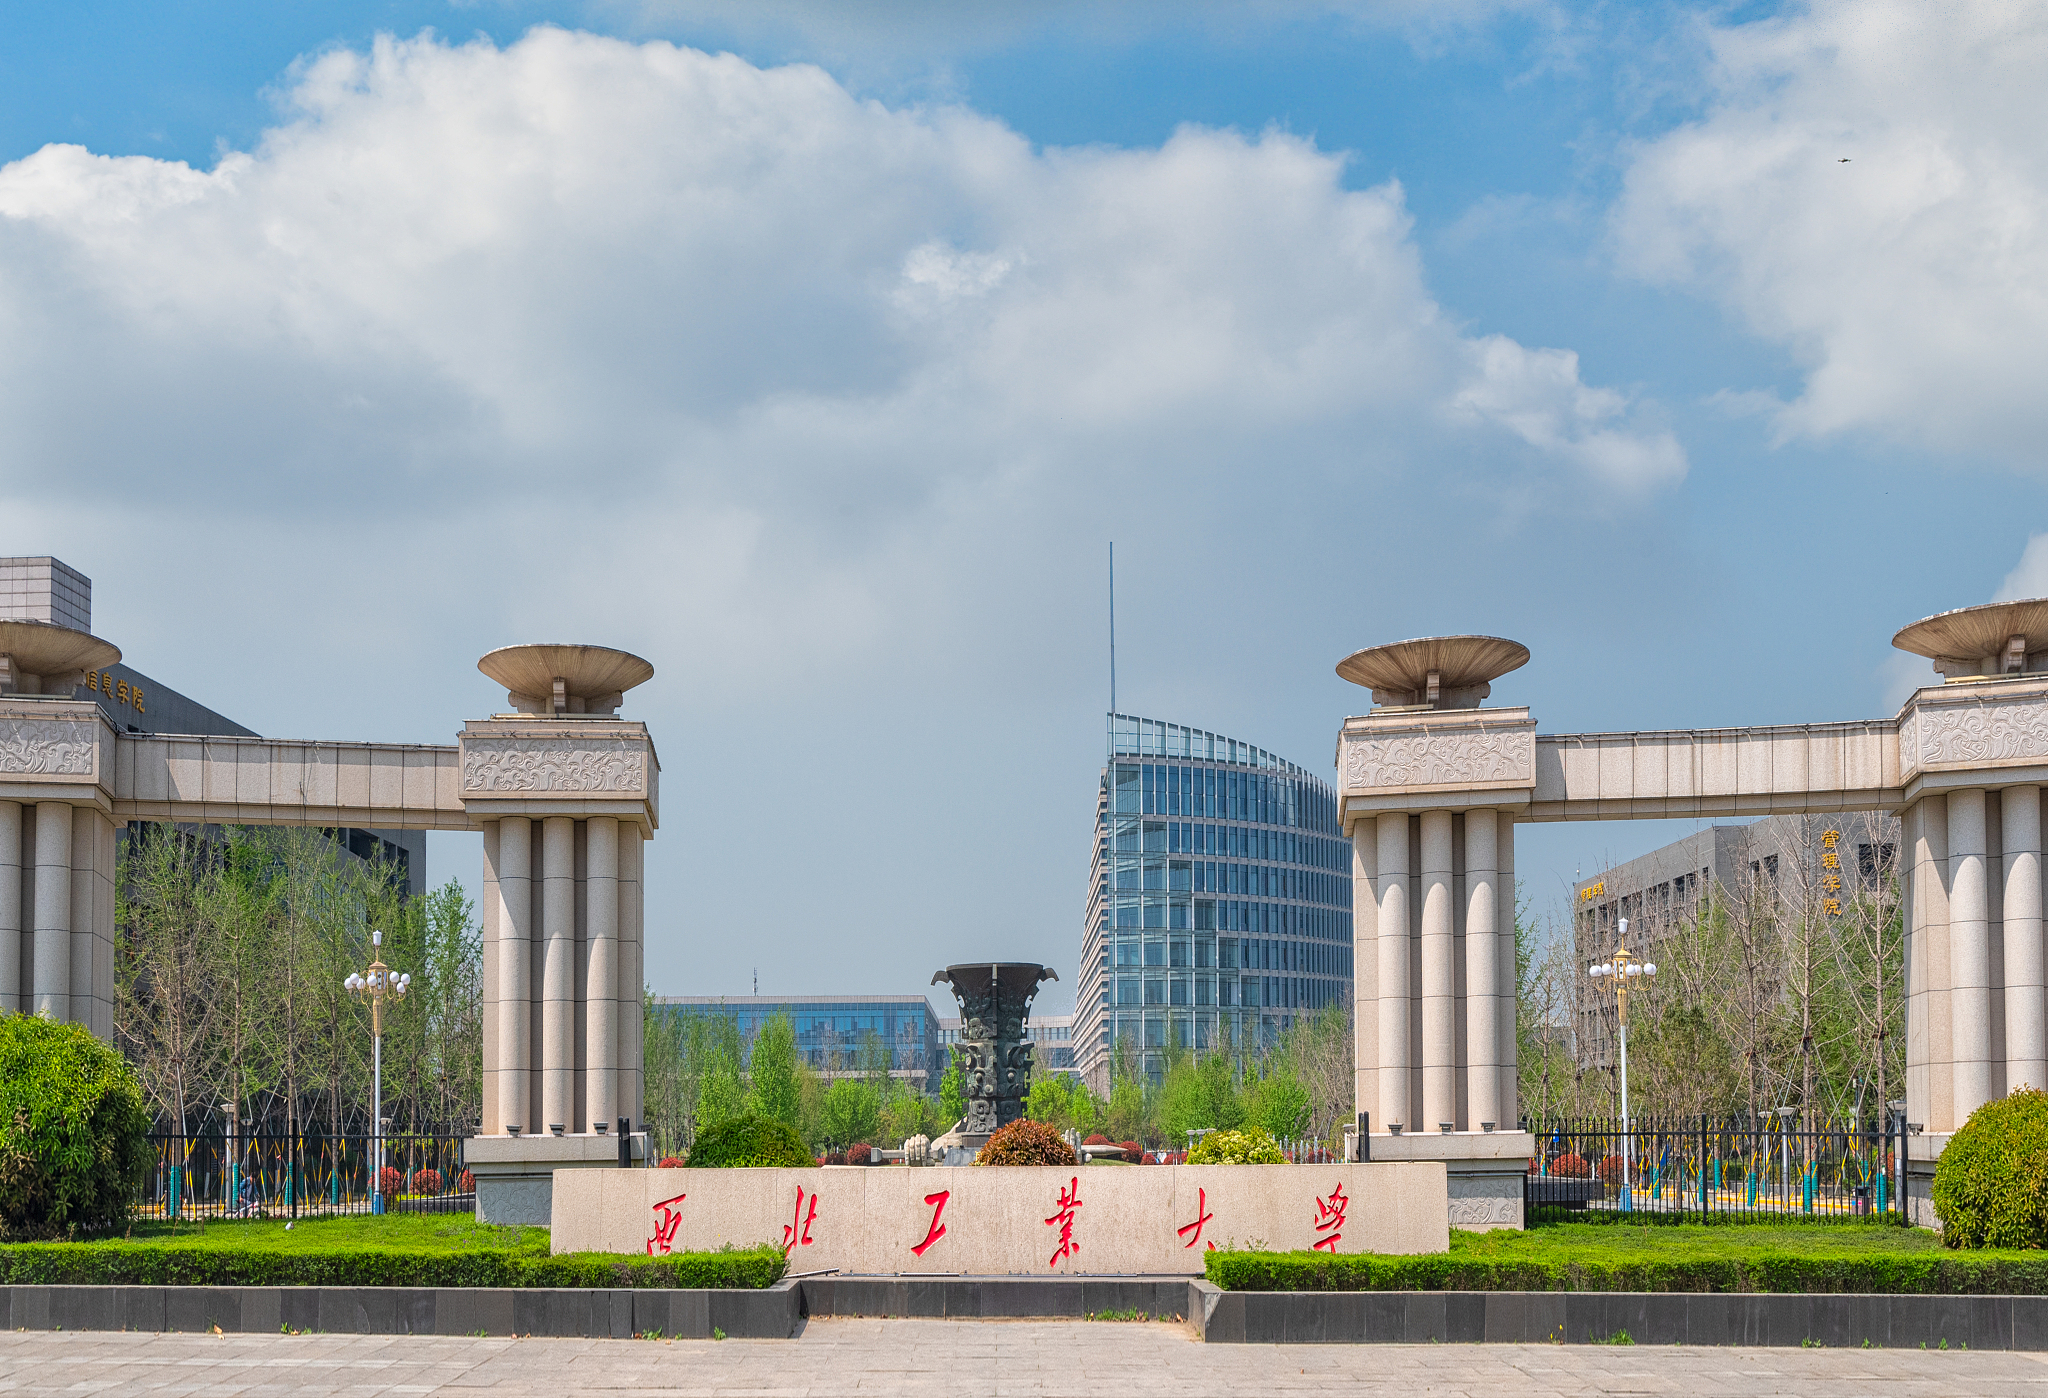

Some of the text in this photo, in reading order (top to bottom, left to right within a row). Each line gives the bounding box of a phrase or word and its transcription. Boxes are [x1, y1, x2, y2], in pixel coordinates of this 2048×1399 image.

[86, 670, 146, 713] 信息学院
[1822, 830, 1842, 915] 管理学院
